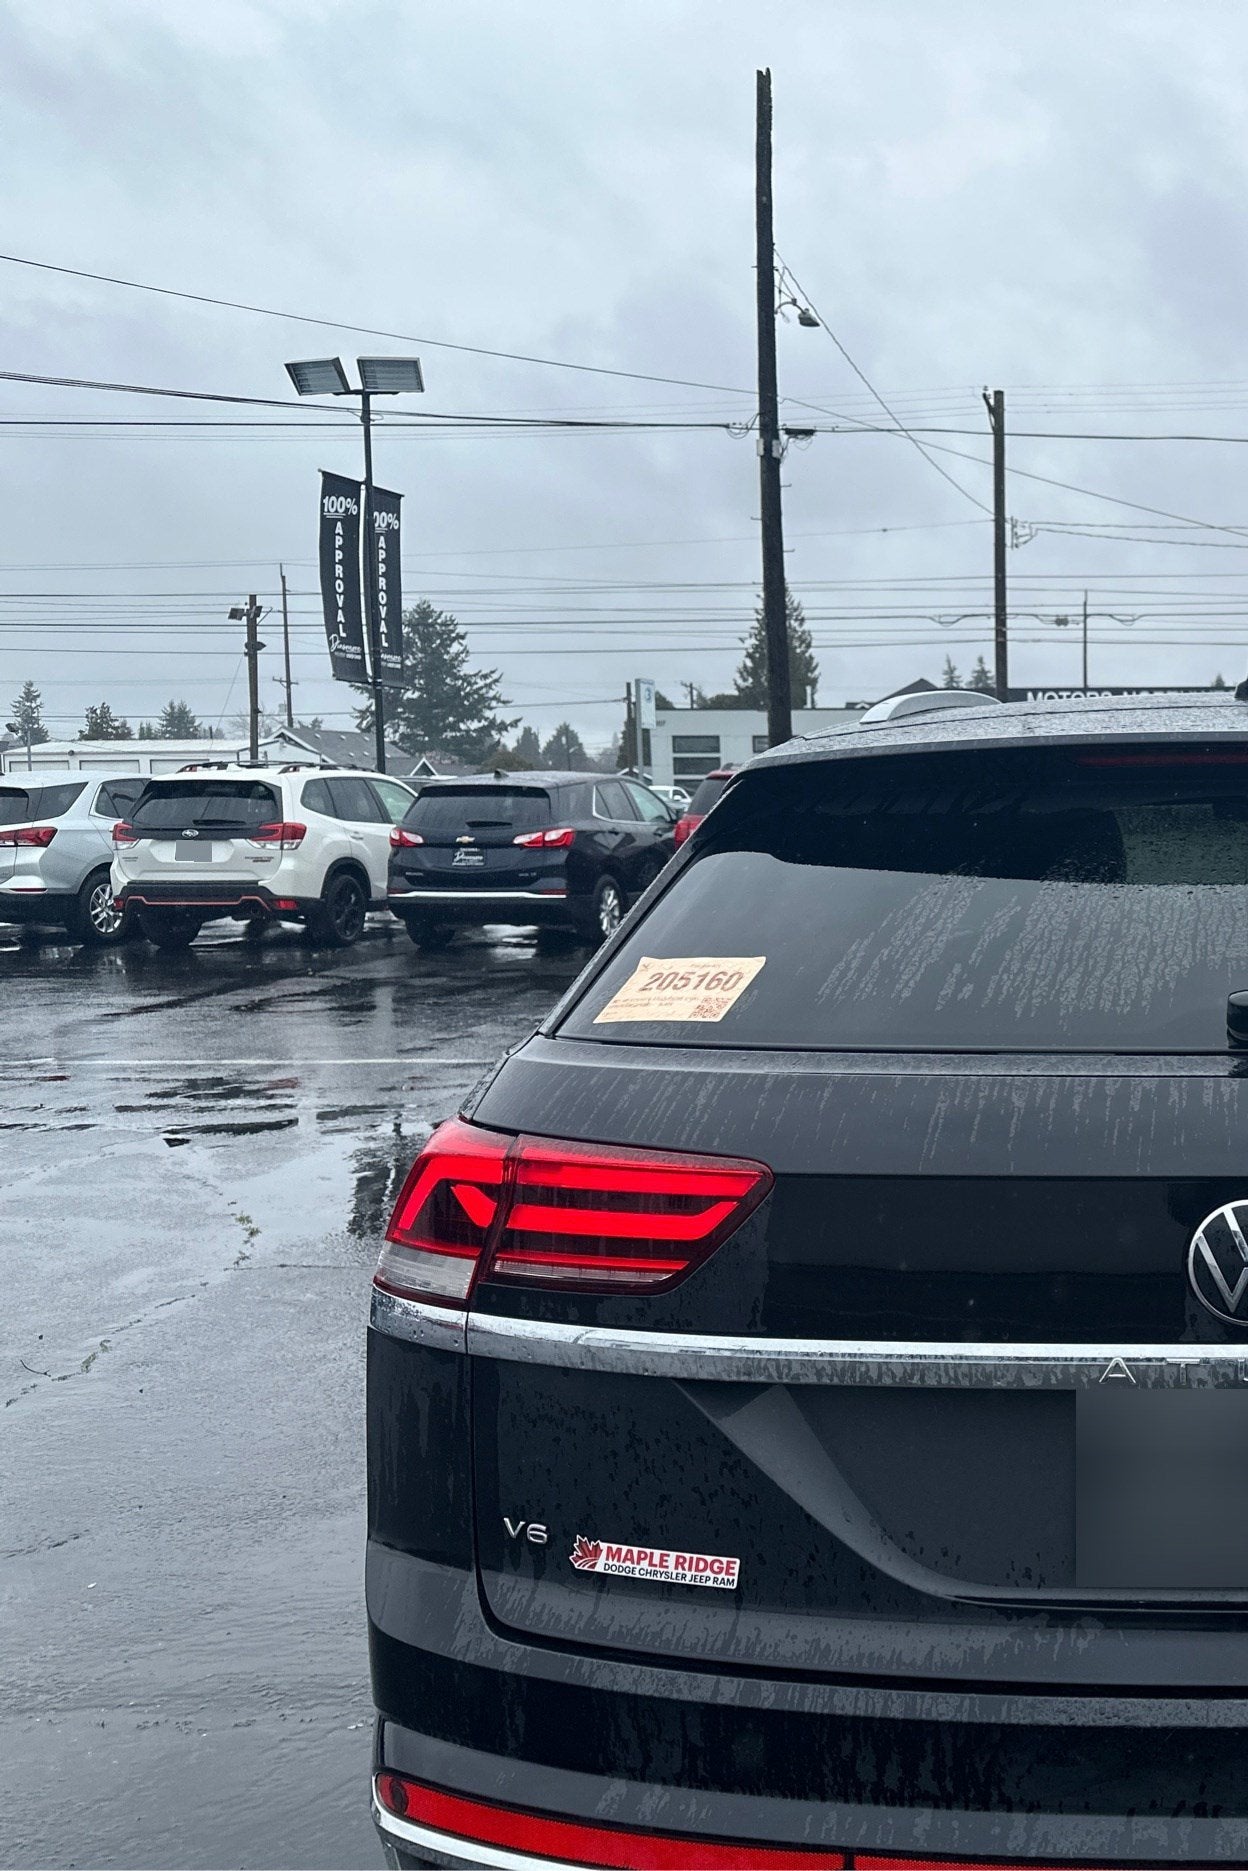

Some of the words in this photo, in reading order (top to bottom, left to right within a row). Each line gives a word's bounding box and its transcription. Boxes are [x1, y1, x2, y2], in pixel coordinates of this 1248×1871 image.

[323, 496, 358, 515] 100%
[373, 511, 399, 530] 00%
[335, 521, 347, 637] APPROVAL
[378, 536, 389, 647] APPROVAL
[639, 970, 744, 992] 205160
[503, 1517, 548, 1545] V6
[605, 1545, 670, 1569] MAPLE
[674, 1554, 737, 1577] RIDGE
[603, 1562, 637, 1576] DODGE
[638, 1567, 687, 1582] CHRYSLER
[688, 1574, 711, 1584] JEEP
[712, 1576, 735, 1587] RAM
